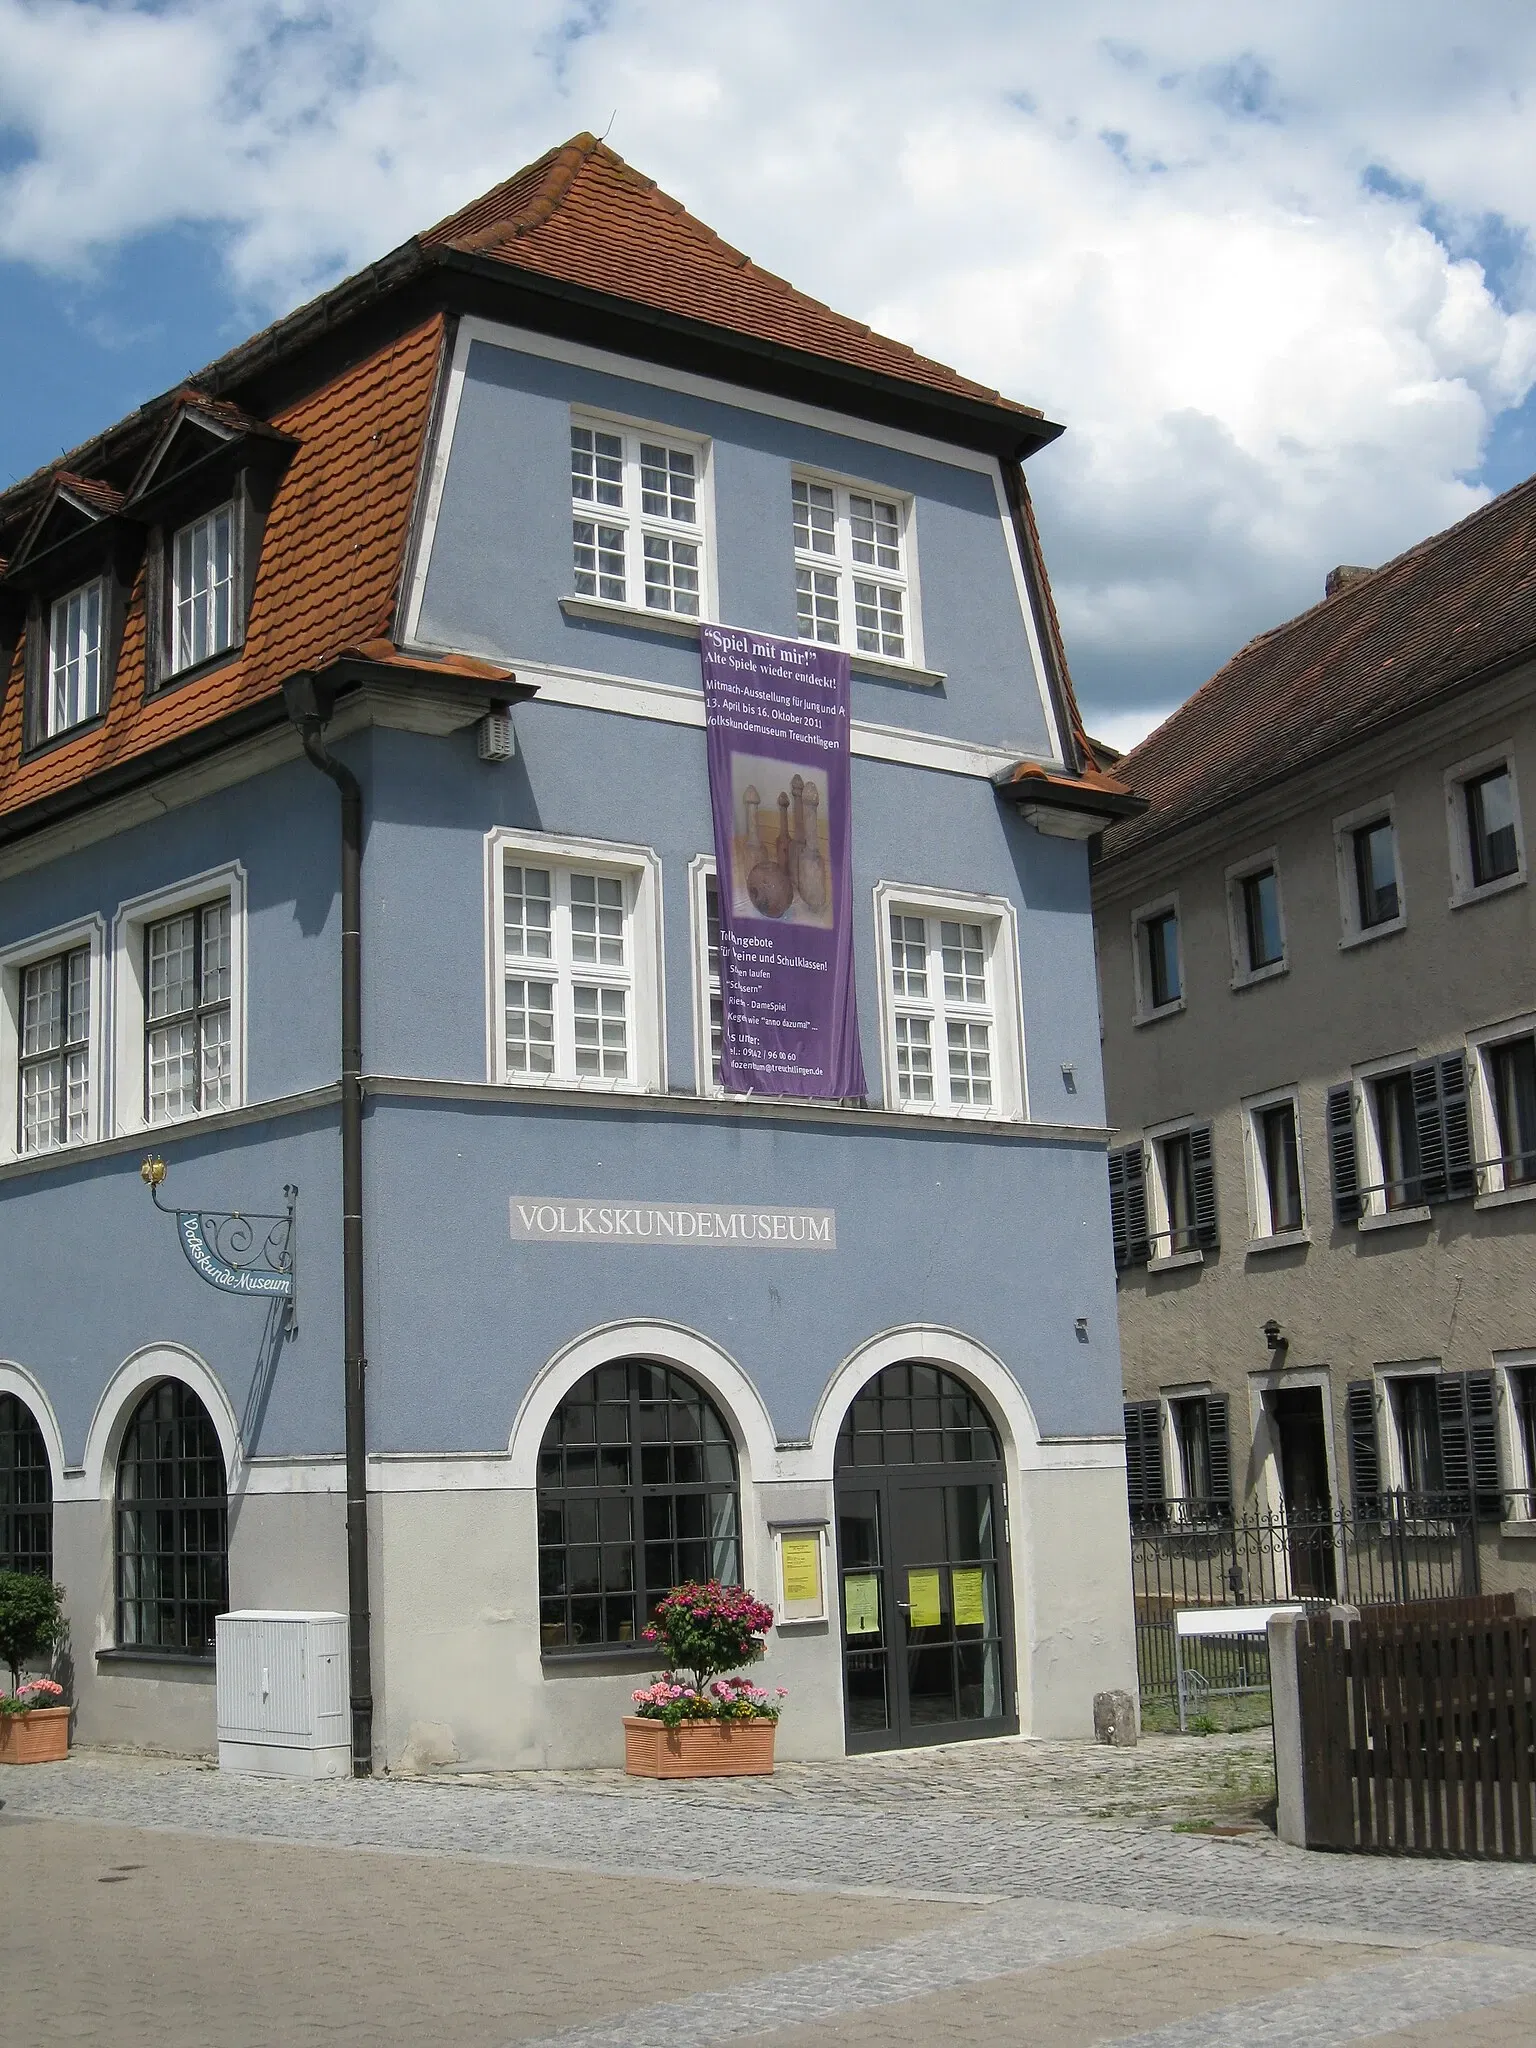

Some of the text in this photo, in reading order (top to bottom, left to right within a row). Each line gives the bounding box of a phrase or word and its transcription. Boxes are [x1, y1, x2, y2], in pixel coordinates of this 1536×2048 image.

[752, 643, 776, 659] mit
[705, 652, 837, 689] Alte Spiele wieder entdeckt!
[706, 679, 790, 706] Mitmach-Ausstellung
[792, 696, 803, 707] für
[803, 699, 820, 714] Jung
[819, 705, 836, 715] und
[706, 697, 822, 729] 13. April bis 16. Oktober 2011
[789, 728, 840, 750] Treuchtlingen
[749, 968, 771, 979] laufen
[759, 954, 775, 964] und
[776, 954, 828, 971] Schulklassen!
[748, 1016, 760, 1025] wie
[768, 1050, 778, 1060] 96
[787, 1052, 797, 1061] 60
[516, 1204, 832, 1241] VOLKSKUNDEMUSEUM
[183, 1217, 290, 1294] Volkskunde-Museum
